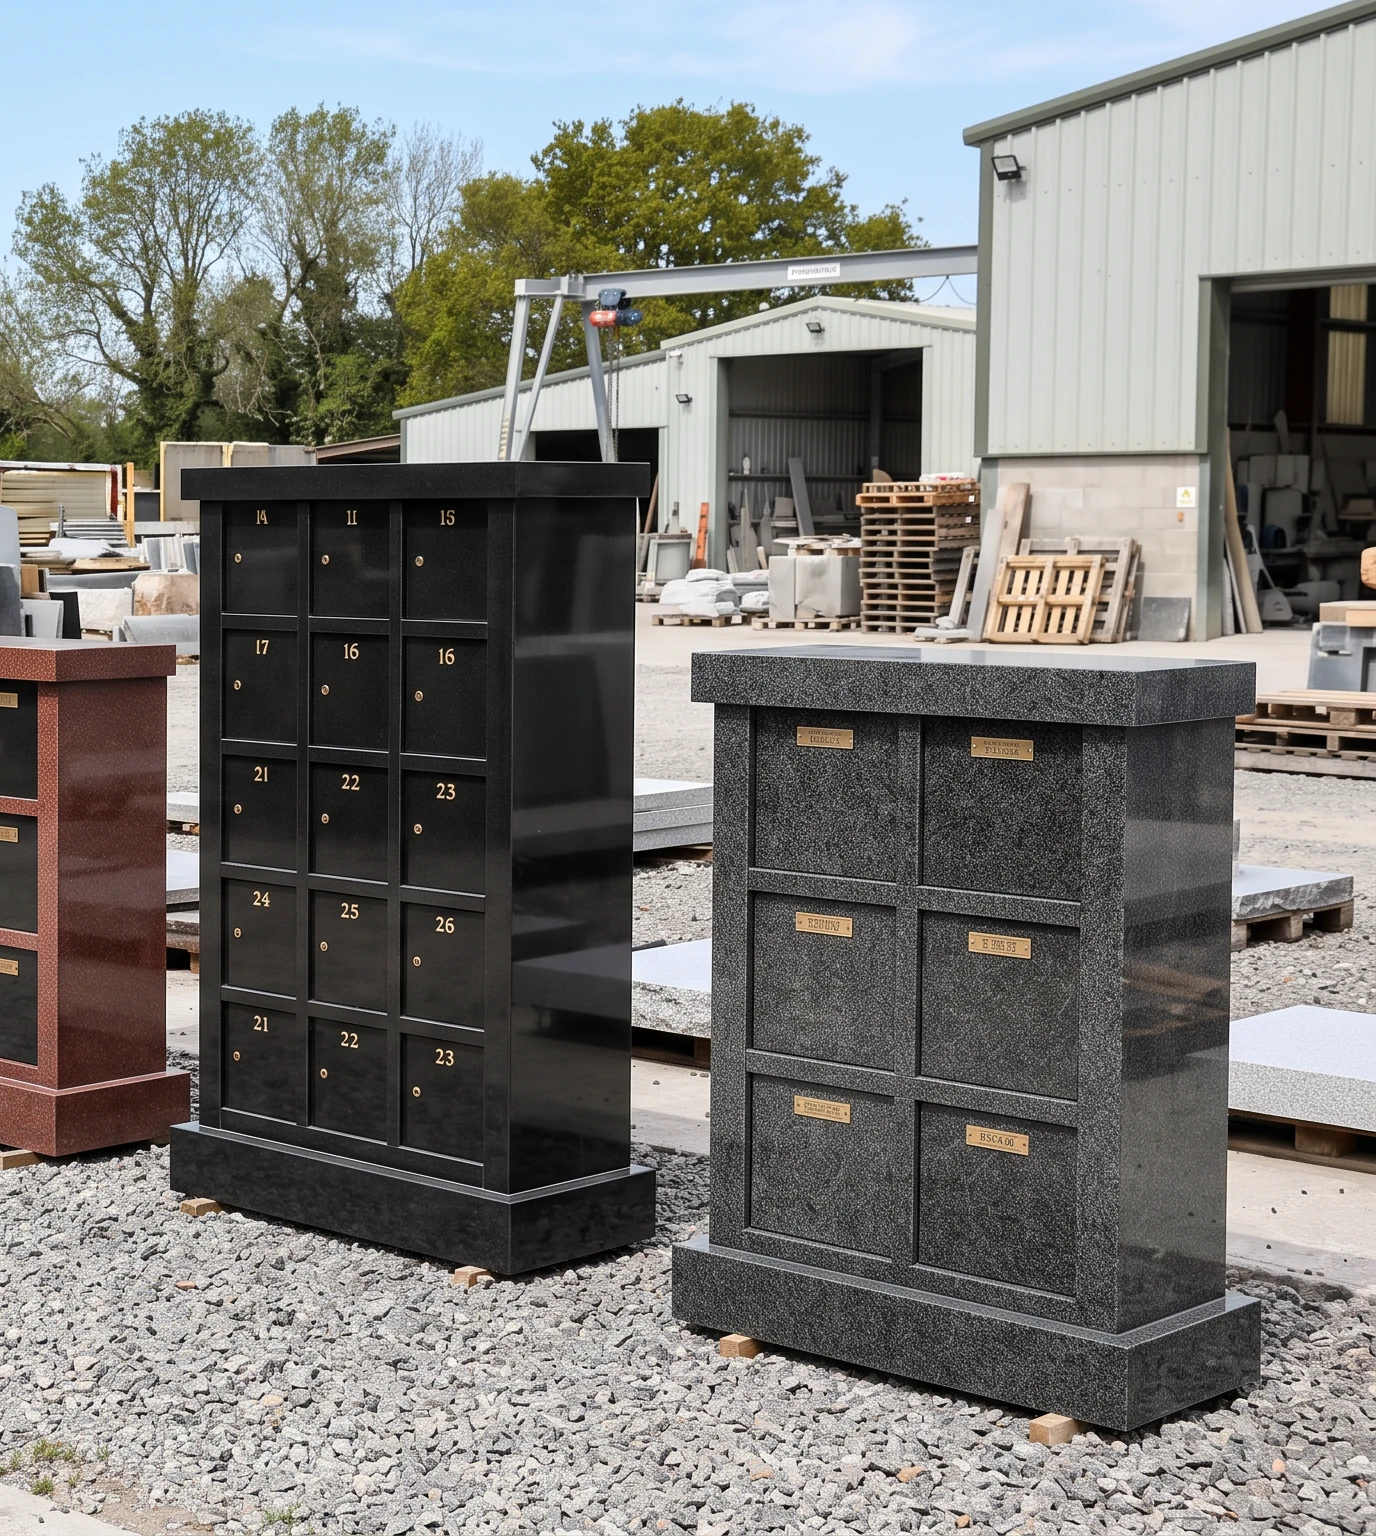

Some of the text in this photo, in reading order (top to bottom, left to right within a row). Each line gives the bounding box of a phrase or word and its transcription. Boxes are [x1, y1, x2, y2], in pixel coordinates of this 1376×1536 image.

[440, 510, 455, 525] 15
[256, 640, 269, 655] 17
[344, 643, 359, 660] 16
[438, 648, 455, 665] 16
[254, 765, 268, 782] 21
[341, 774, 360, 791] 22
[436, 783, 456, 800] 23
[253, 891, 270, 908] 24
[340, 903, 359, 919] 25
[435, 917, 455, 934] 26
[253, 1015, 269, 1032] 21
[340, 1031, 359, 1049] 22
[435, 1049, 455, 1067] 23
